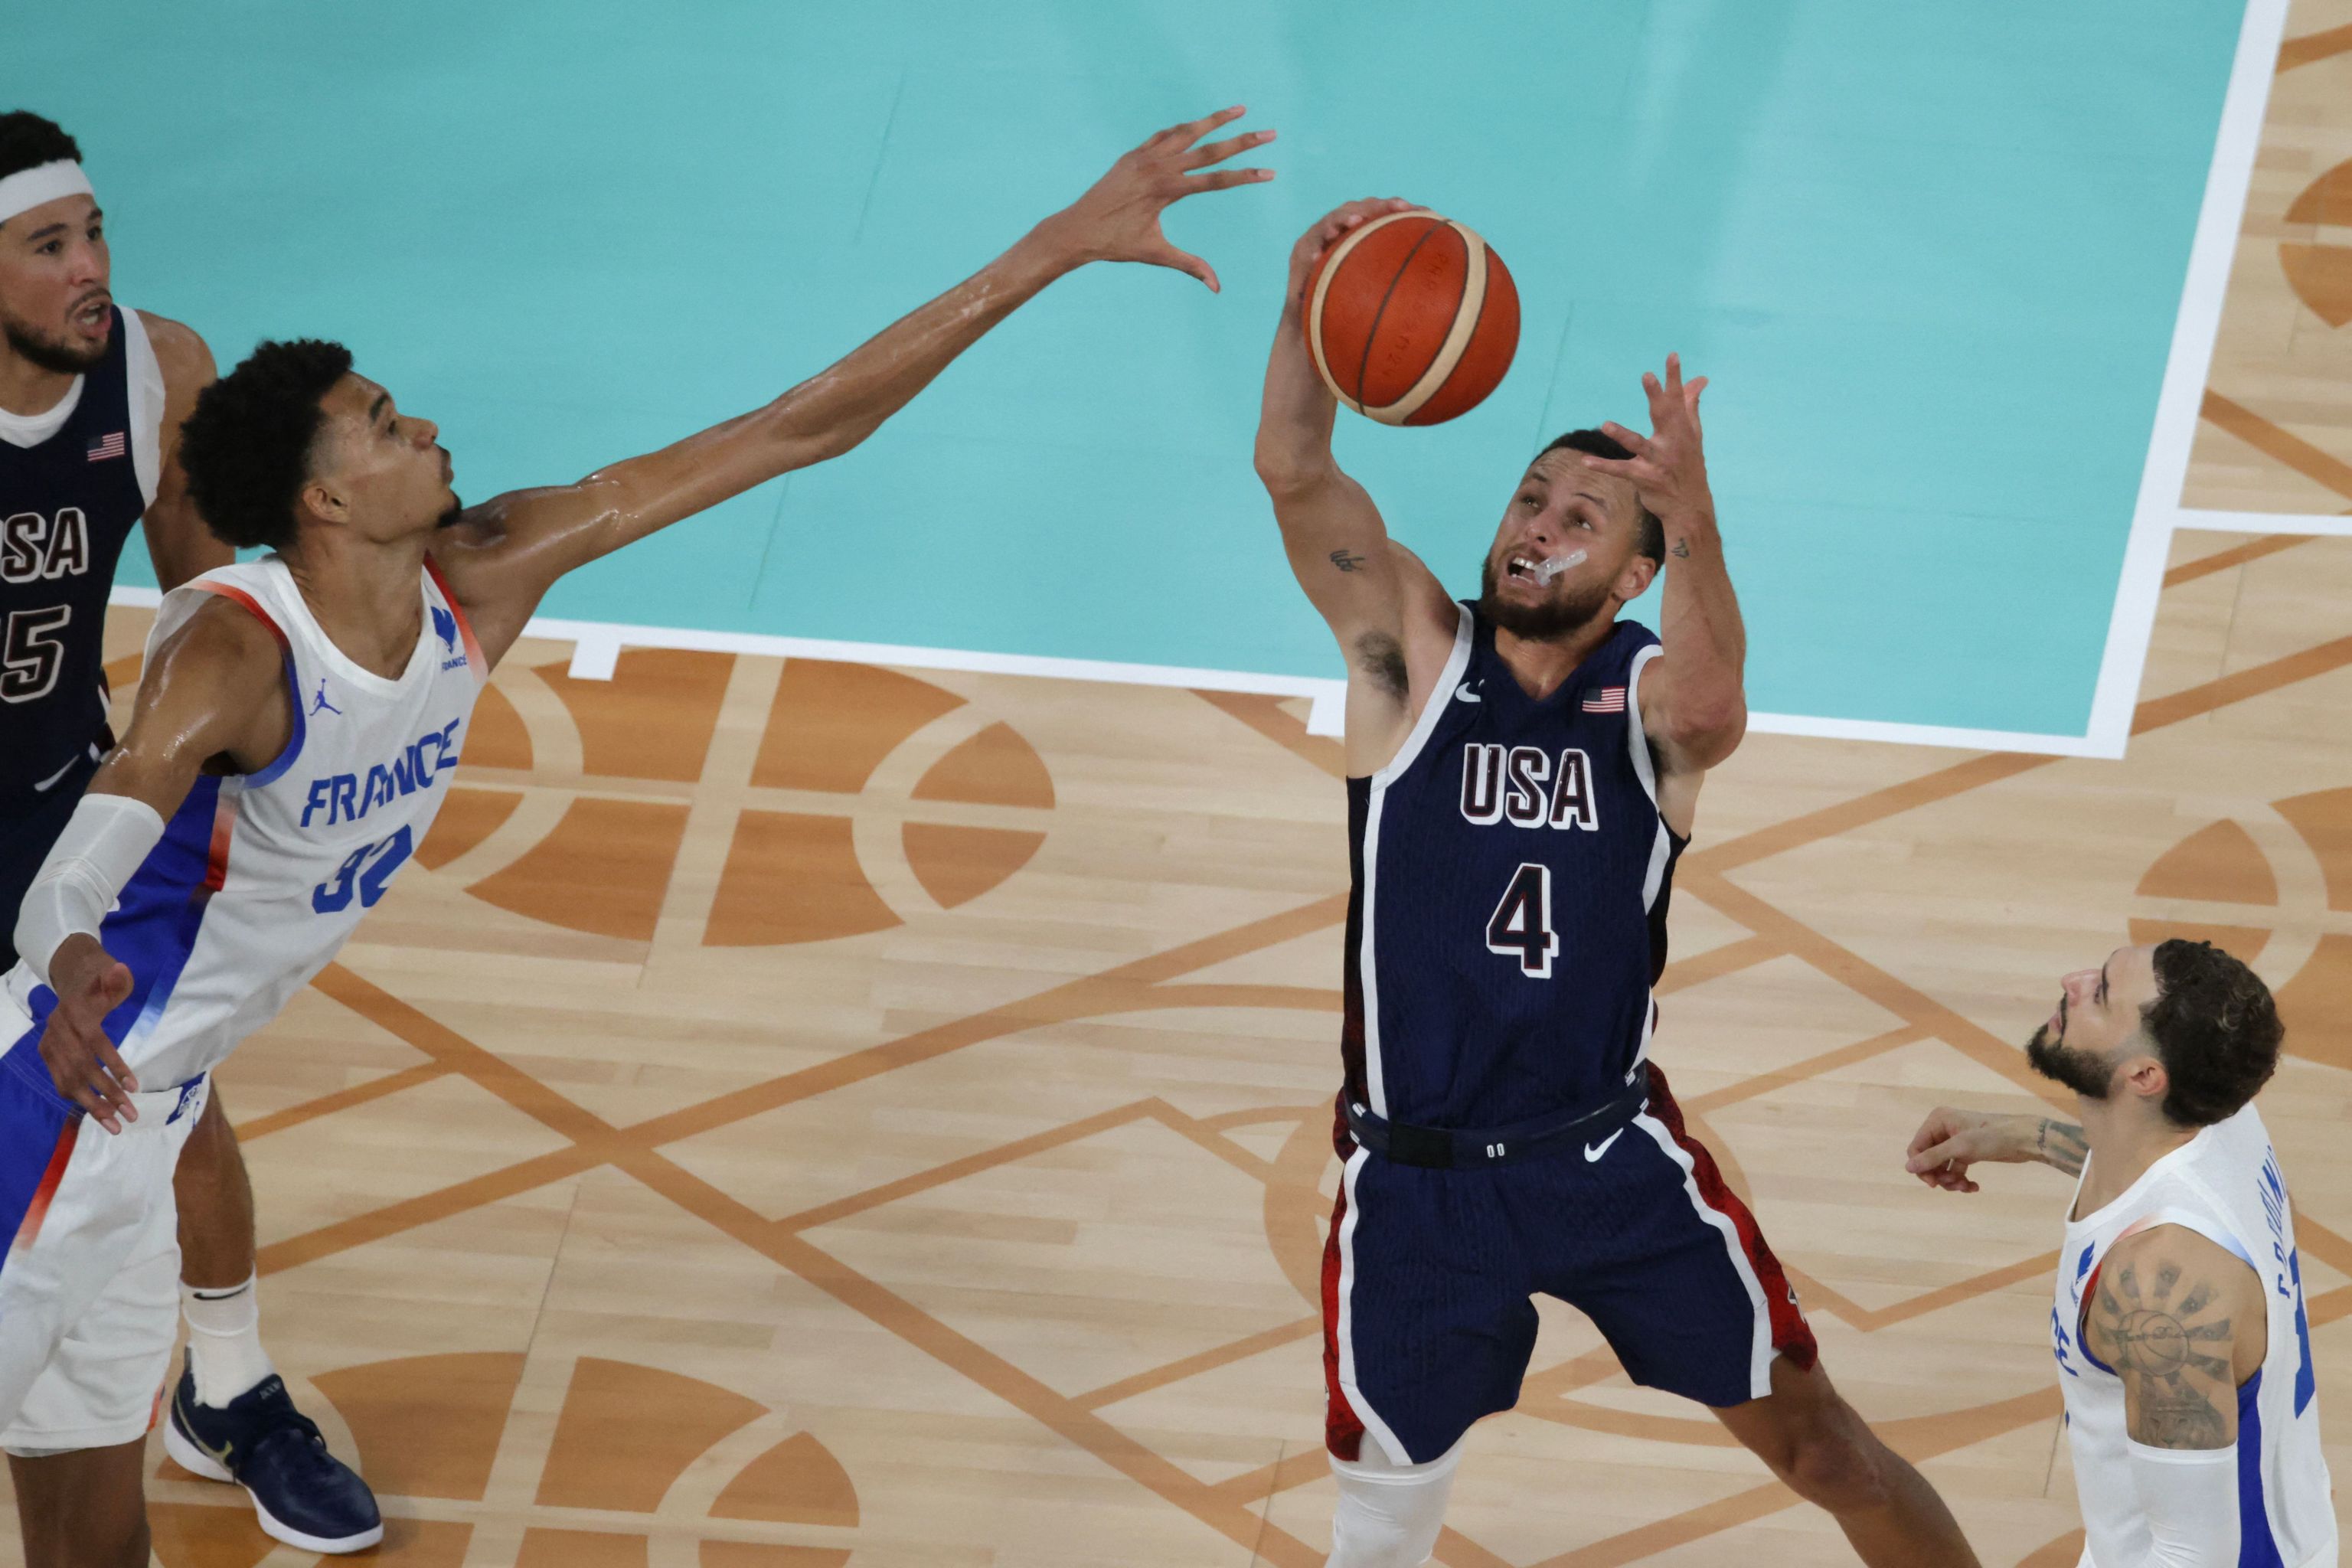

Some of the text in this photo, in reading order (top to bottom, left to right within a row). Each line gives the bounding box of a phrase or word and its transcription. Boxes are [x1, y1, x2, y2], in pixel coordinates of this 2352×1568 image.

[0, 507, 89, 583] SA
[0, 604, 71, 704] 5
[300, 717, 459, 828] FRANCE
[1460, 743, 1599, 831] USA
[312, 823, 413, 914] 32
[1486, 862, 1560, 979] 4
